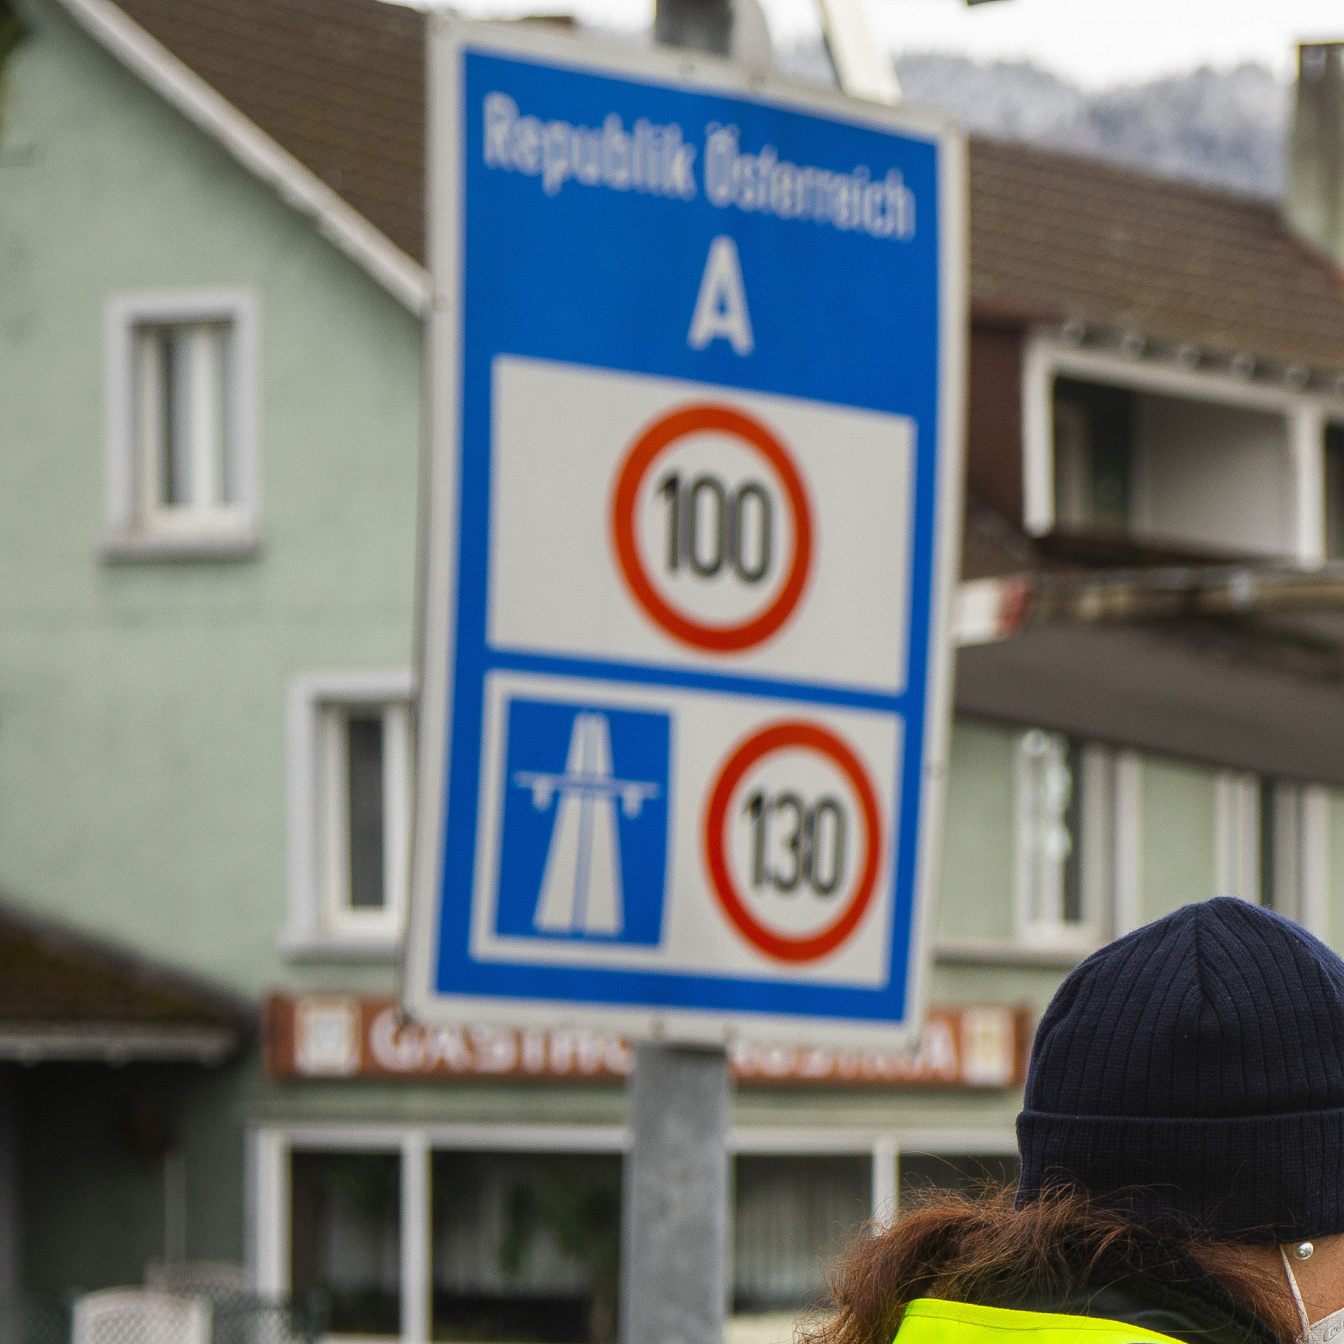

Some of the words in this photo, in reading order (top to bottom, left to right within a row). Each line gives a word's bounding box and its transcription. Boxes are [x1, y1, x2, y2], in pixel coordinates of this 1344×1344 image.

[483, 91, 698, 201] Republik
[704, 121, 917, 242] Österreich
[686, 235, 755, 357] A
[657, 467, 774, 586] 100
[744, 787, 848, 898] 130
